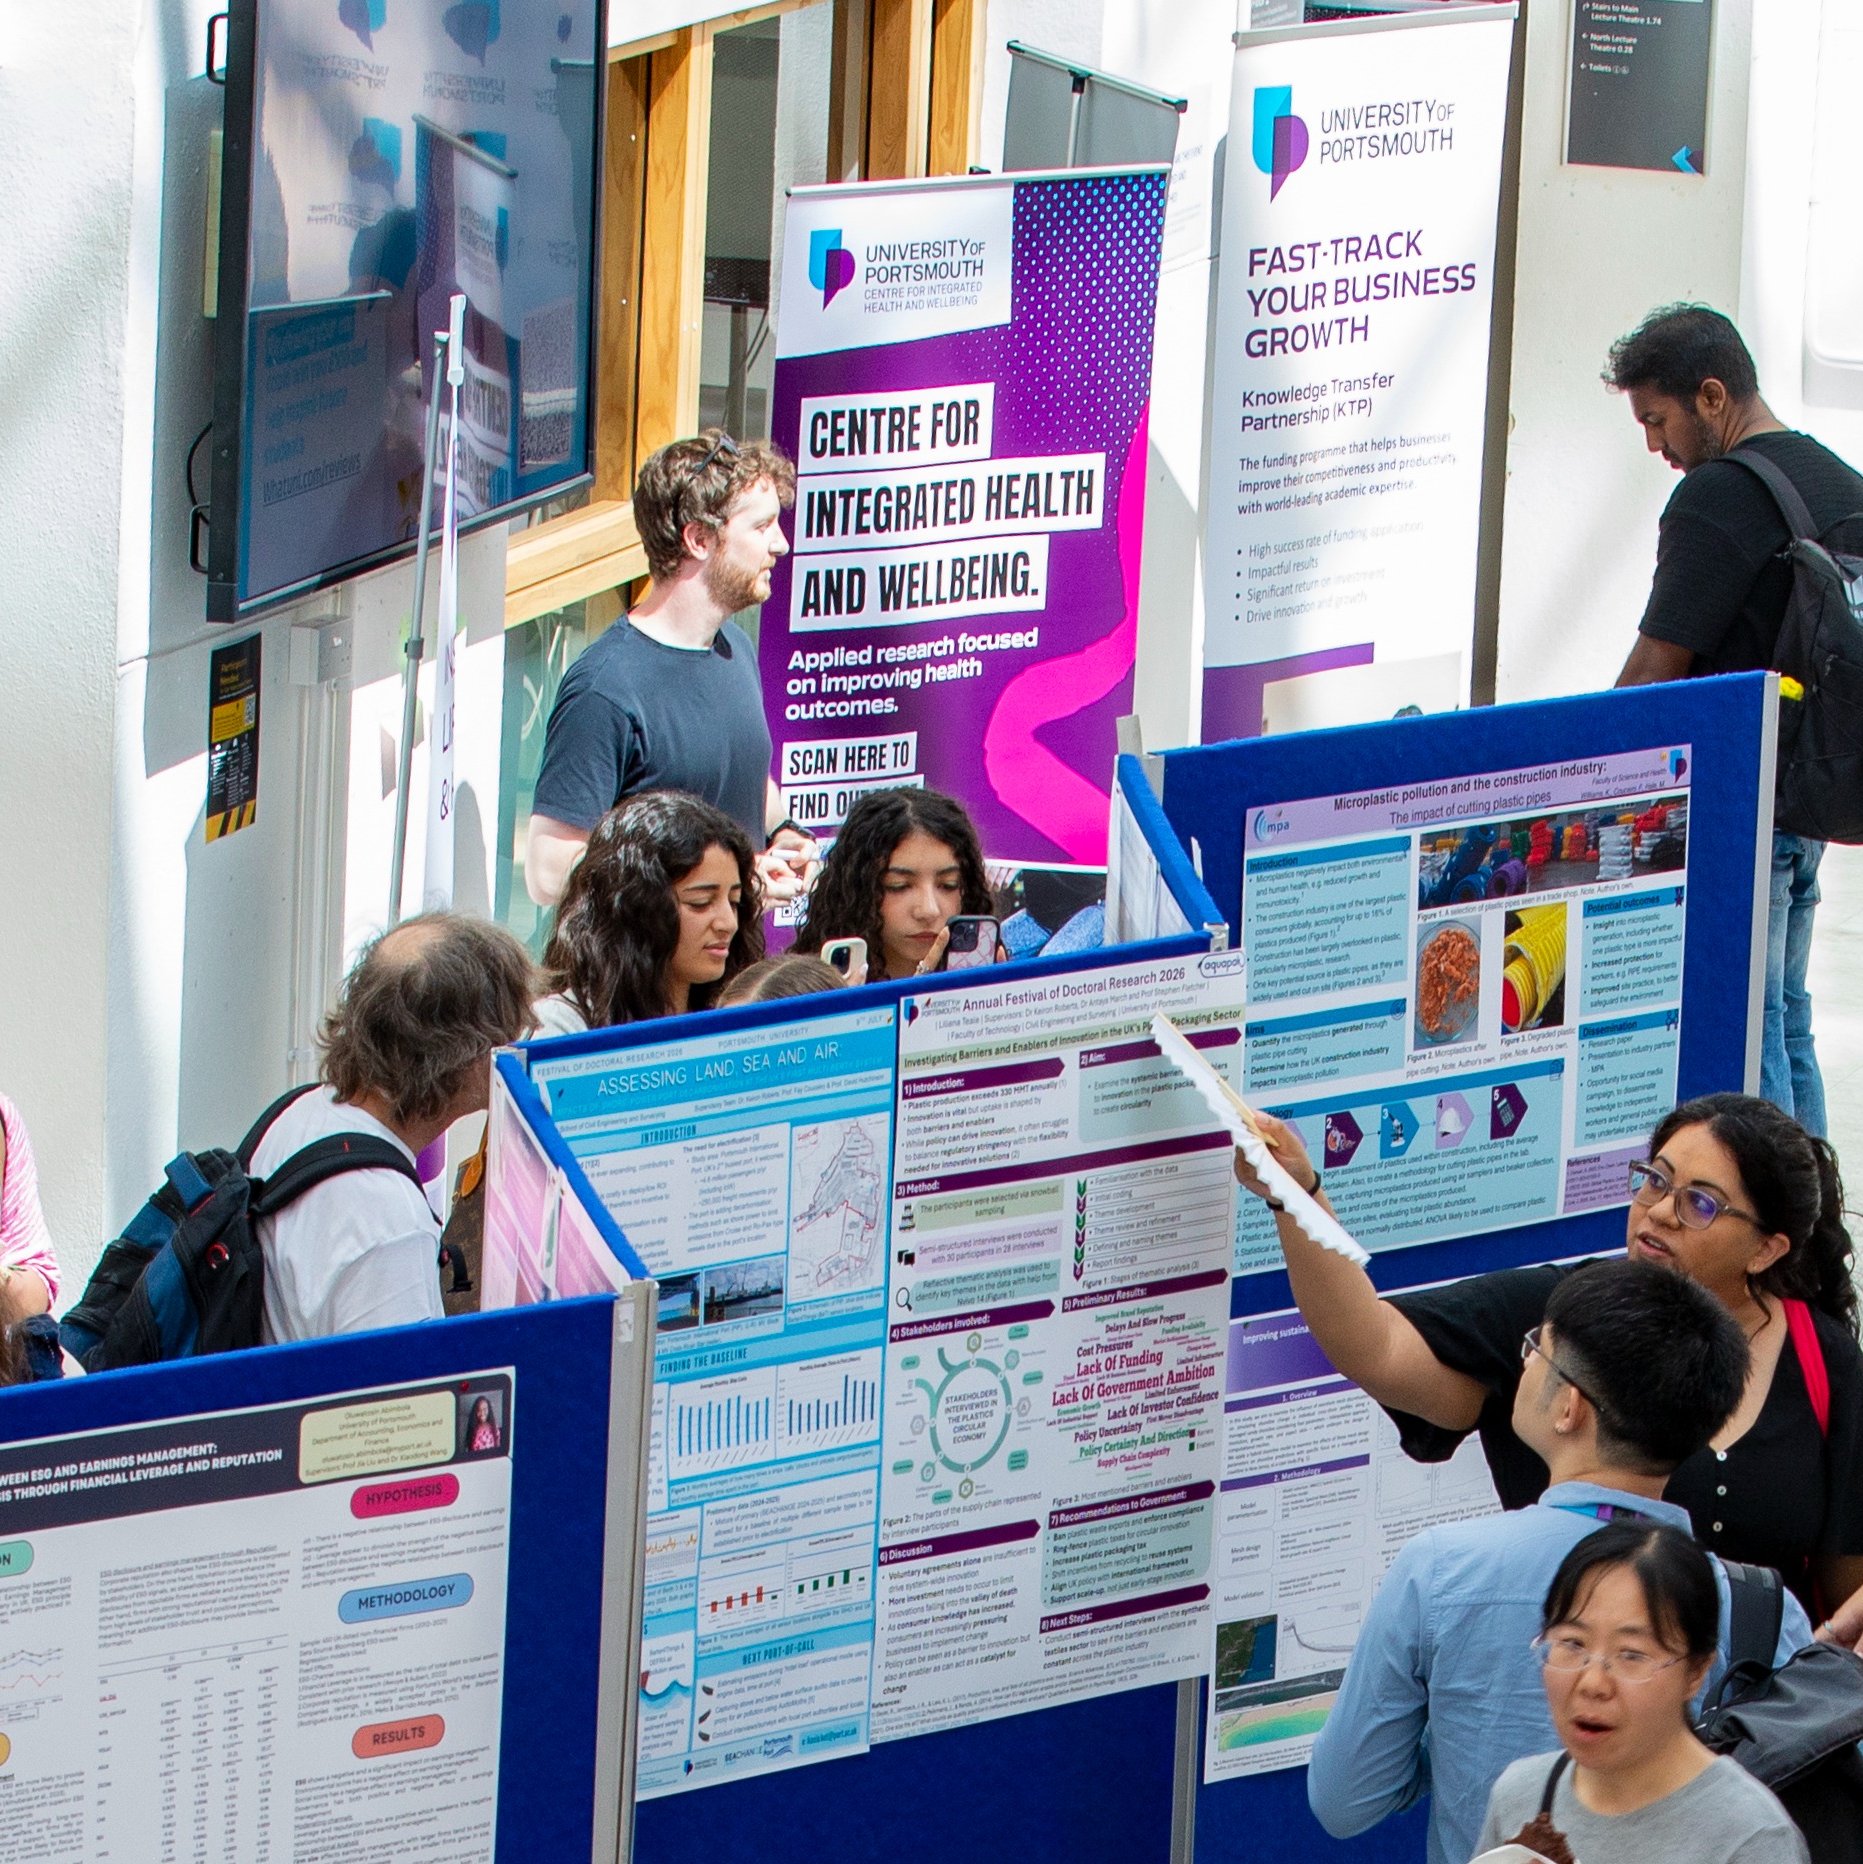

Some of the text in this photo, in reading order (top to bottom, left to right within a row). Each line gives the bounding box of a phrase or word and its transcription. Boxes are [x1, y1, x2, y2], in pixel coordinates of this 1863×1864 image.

[1591, 13, 1617, 21] Lecture
[1618, 15, 1645, 24] Theatre
[1590, 43, 1616, 52] Theatre
[1611, 34, 1638, 44] Lecture
[1588, 63, 1612, 73] Toilets
[1319, 127, 1453, 164] PORTSMOUTH
[864, 258, 984, 284] PORTSMOUTH
[1248, 229, 1423, 277] FAST-TRACK
[863, 280, 983, 301] CENTRE FOR INTEGRATED
[863, 293, 978, 314] HEALTH AND WELLBEING
[1246, 262, 1476, 317] YOUR BUSINESS
[1244, 314, 1369, 359] GROWTH
[1242, 371, 1395, 408] Knowledge Transfer
[809, 399, 979, 459] CENTRE FOR
[1241, 396, 1372, 432] Partnership (KTP)
[805, 469, 1094, 538] INTEGRATED HEALTH
[800, 551, 1038, 618] AND WELLBEING.
[787, 626, 1039, 673] Applied research focused
[786, 657, 982, 695] on improving health
[784, 696, 899, 720] outcomes.
[789, 740, 909, 776] SCAN HERE TO
[1333, 761, 1607, 811] Microplastic pollution and the construction industry:
[785, 791, 829, 821] FIND
[962, 966, 1185, 1012] Annual Festival of Doctoral Research 2026
[596, 1040, 839, 1096] ASSESSING LAND SEA AND AIR
[640, 1124, 698, 1145] INTRODUCTION
[1075, 1350, 1164, 1377] Lack Of Funding
[1051, 1364, 1215, 1407] Lack Of Government Ambition
[12, 1480, 68, 1500] THROUGH
[69, 1471, 129, 1492] FINANCIAL
[128, 1462, 184, 1482] LEVERAGE
[185, 1458, 211, 1473] AND
[211, 1448, 283, 1470] REPUTATION
[30, 1467, 53, 1482] ESG
[53, 1463, 78, 1478] AND
[78, 1454, 136, 1474] EARNINGS
[136, 1443, 218, 1466] MANAGEMENT:
[365, 1481, 442, 1506] HYPOTHESIS
[357, 1582, 456, 1610] METHODOLOGY
[372, 1724, 425, 1745] RESULTS
